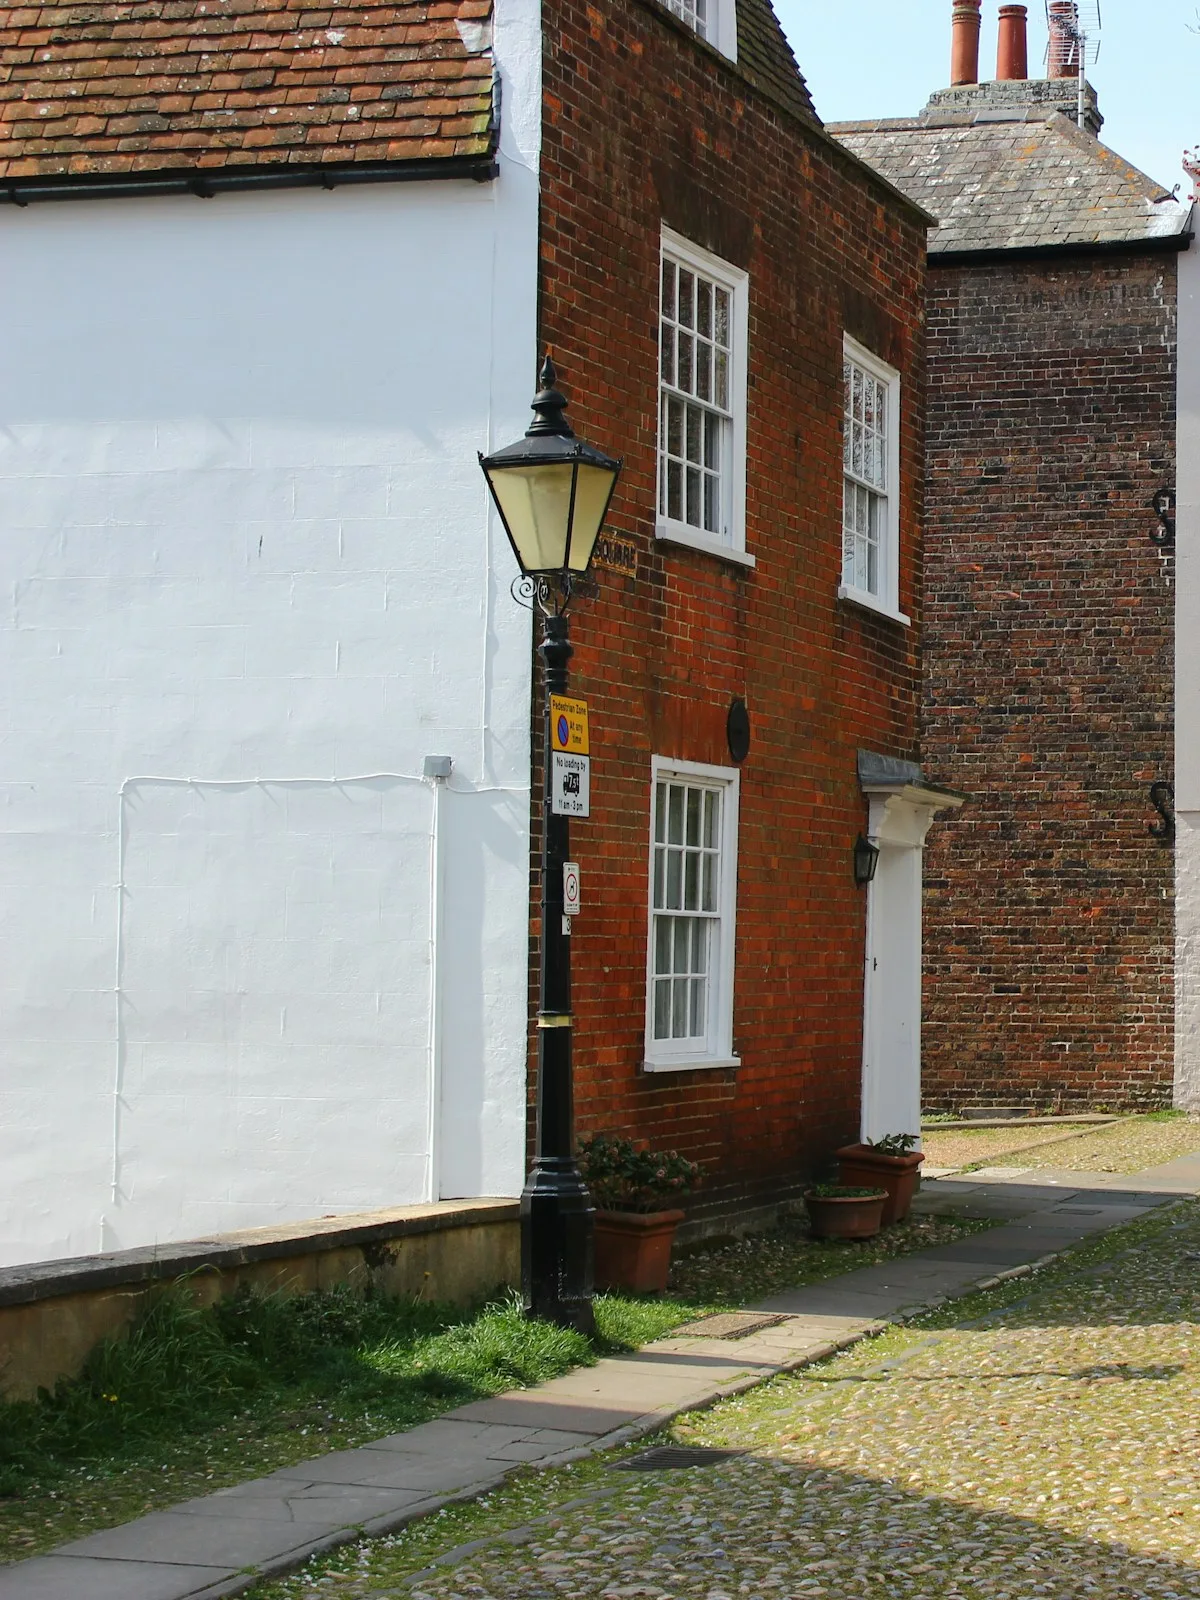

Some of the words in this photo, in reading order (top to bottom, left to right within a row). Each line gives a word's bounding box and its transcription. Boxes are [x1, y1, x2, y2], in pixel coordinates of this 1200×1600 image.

[553, 699, 575, 713] Pedestrian
[576, 704, 586, 716] Zone
[570, 720, 575, 730] At
[572, 734, 582, 744] time
[557, 756, 563, 767] No
[564, 758, 579, 771] loading
[581, 760, 586, 772] by
[559, 799, 563, 809] 11
[577, 803, 583, 811] pm
